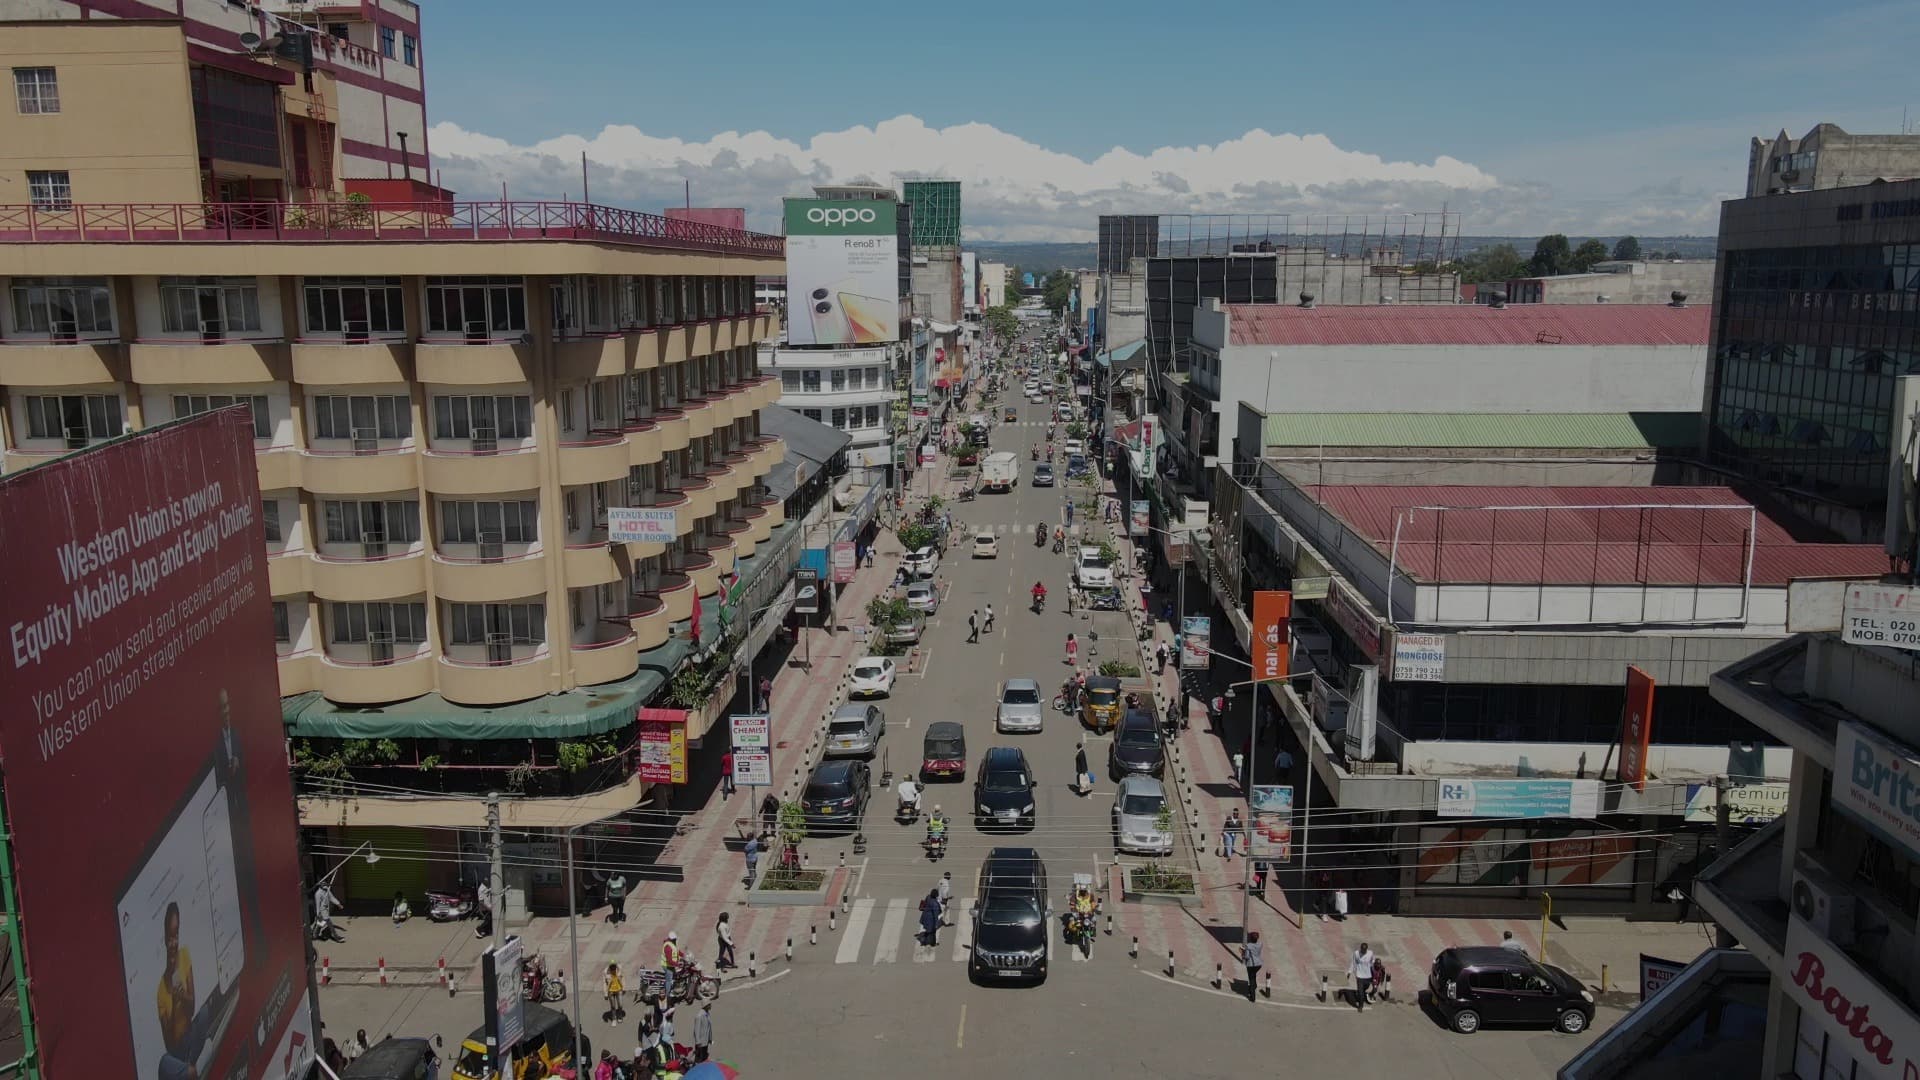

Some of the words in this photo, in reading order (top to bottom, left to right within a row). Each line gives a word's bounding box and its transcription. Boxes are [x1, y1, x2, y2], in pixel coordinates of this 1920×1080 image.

[807, 208, 876, 227] oppo
[610, 511, 643, 520] AVENUE
[644, 511, 674, 521] SUITES
[57, 530, 130, 585] Western
[129, 507, 171, 549] Union
[168, 496, 184, 528] is
[207, 480, 224, 510] on
[618, 520, 663, 532] HOTEL
[612, 532, 642, 541] SUPERB
[9, 602, 72, 669] Equity
[73, 569, 130, 629] Mobile
[131, 556, 158, 597] App
[160, 536, 184, 577] and
[184, 517, 220, 565] Equity
[220, 495, 254, 540] Online!
[1851, 617, 1884, 630] TEL:
[1890, 620, 1916, 632] 020
[32, 685, 63, 724] You
[66, 664, 94, 699] can
[96, 642, 124, 680] now
[126, 616, 155, 660] send
[157, 607, 177, 637] and
[177, 586, 212, 621] receive
[213, 566, 242, 602] money
[242, 553, 254, 575] via
[1397, 636, 1433, 646] MANAGED
[1434, 637, 1443, 646] BY
[1852, 629, 1888, 642] MOB:
[1263, 622, 1279, 677] naivas
[1397, 651, 1443, 661] MONGOOSE
[37, 696, 102, 762] Western
[102, 670, 141, 711] Union
[143, 638, 185, 682] straight
[186, 617, 210, 647] from
[210, 602, 229, 631] your
[230, 580, 256, 617] phone.
[1730, 788, 1788, 800] remiu
[1790, 951, 1894, 1065] Bata
